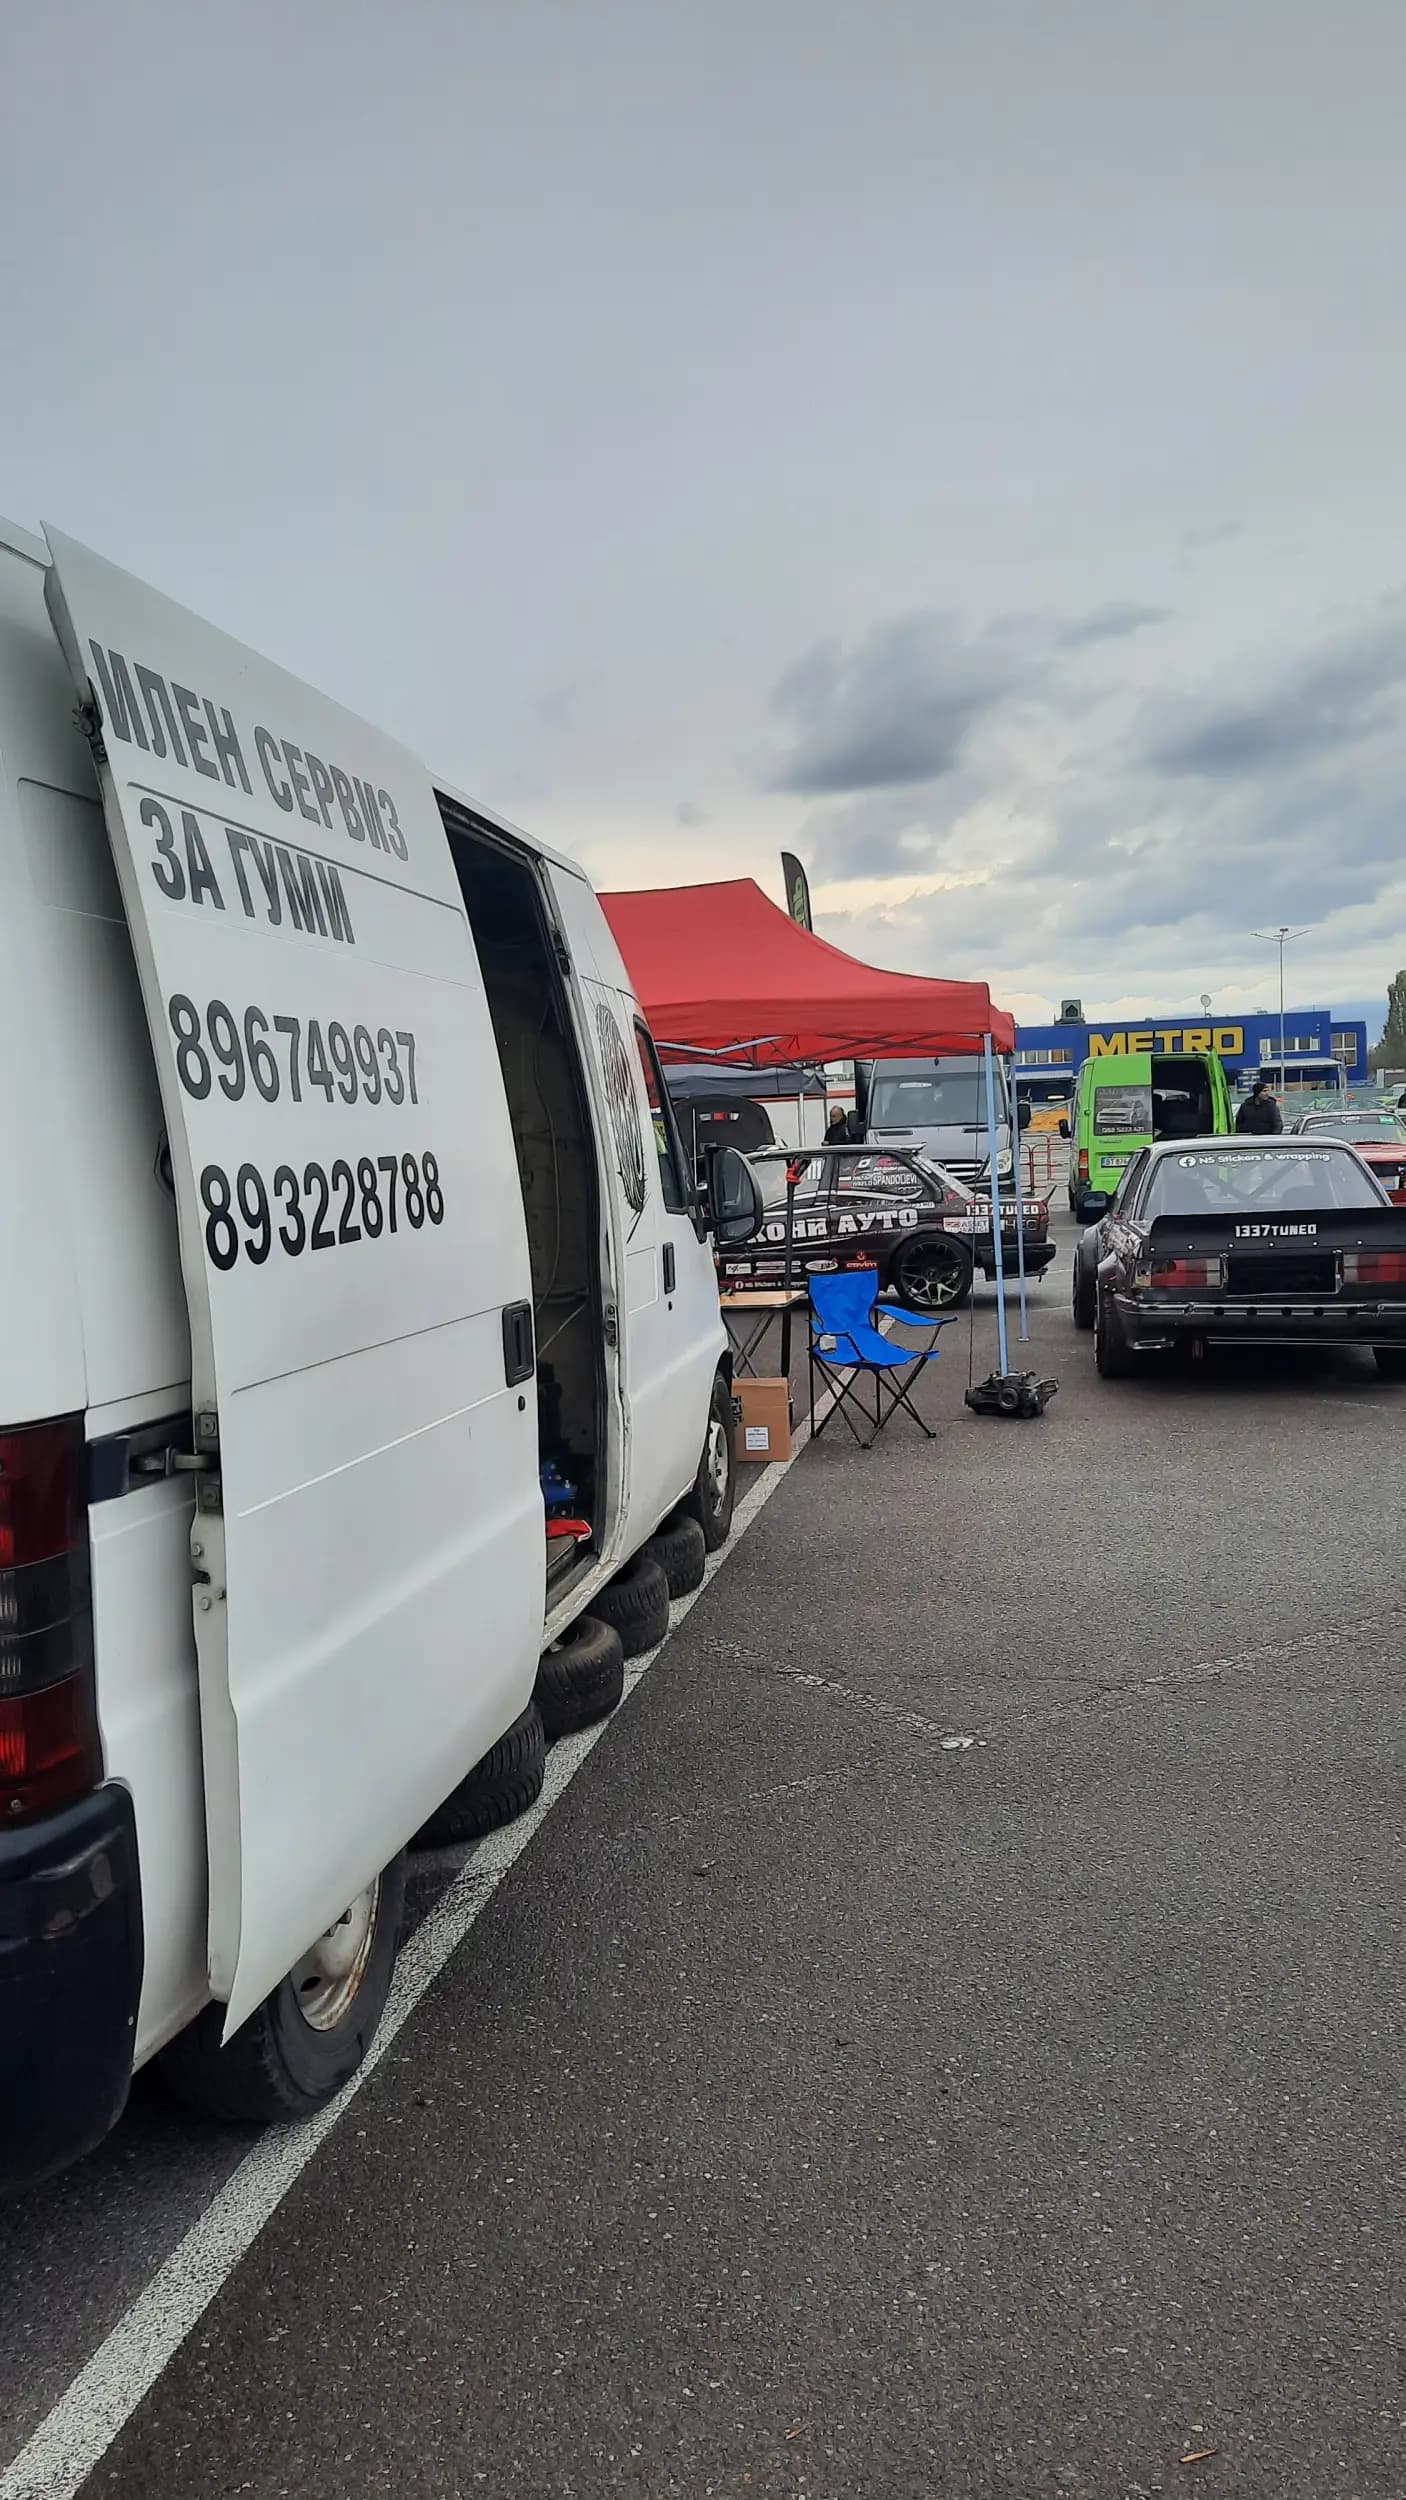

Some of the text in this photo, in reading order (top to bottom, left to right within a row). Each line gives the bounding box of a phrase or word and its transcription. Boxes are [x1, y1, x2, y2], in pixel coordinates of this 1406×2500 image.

[254, 726, 409, 861] СЕРВИЗ
[140, 797, 355, 944] ЗА ГУММИ
[169, 994, 420, 1105] 896749937
[1089, 1027, 1244, 1057] METRO
[200, 1151, 444, 1271] 893228788
[1235, 1224, 1317, 1237] 1337TUNED
